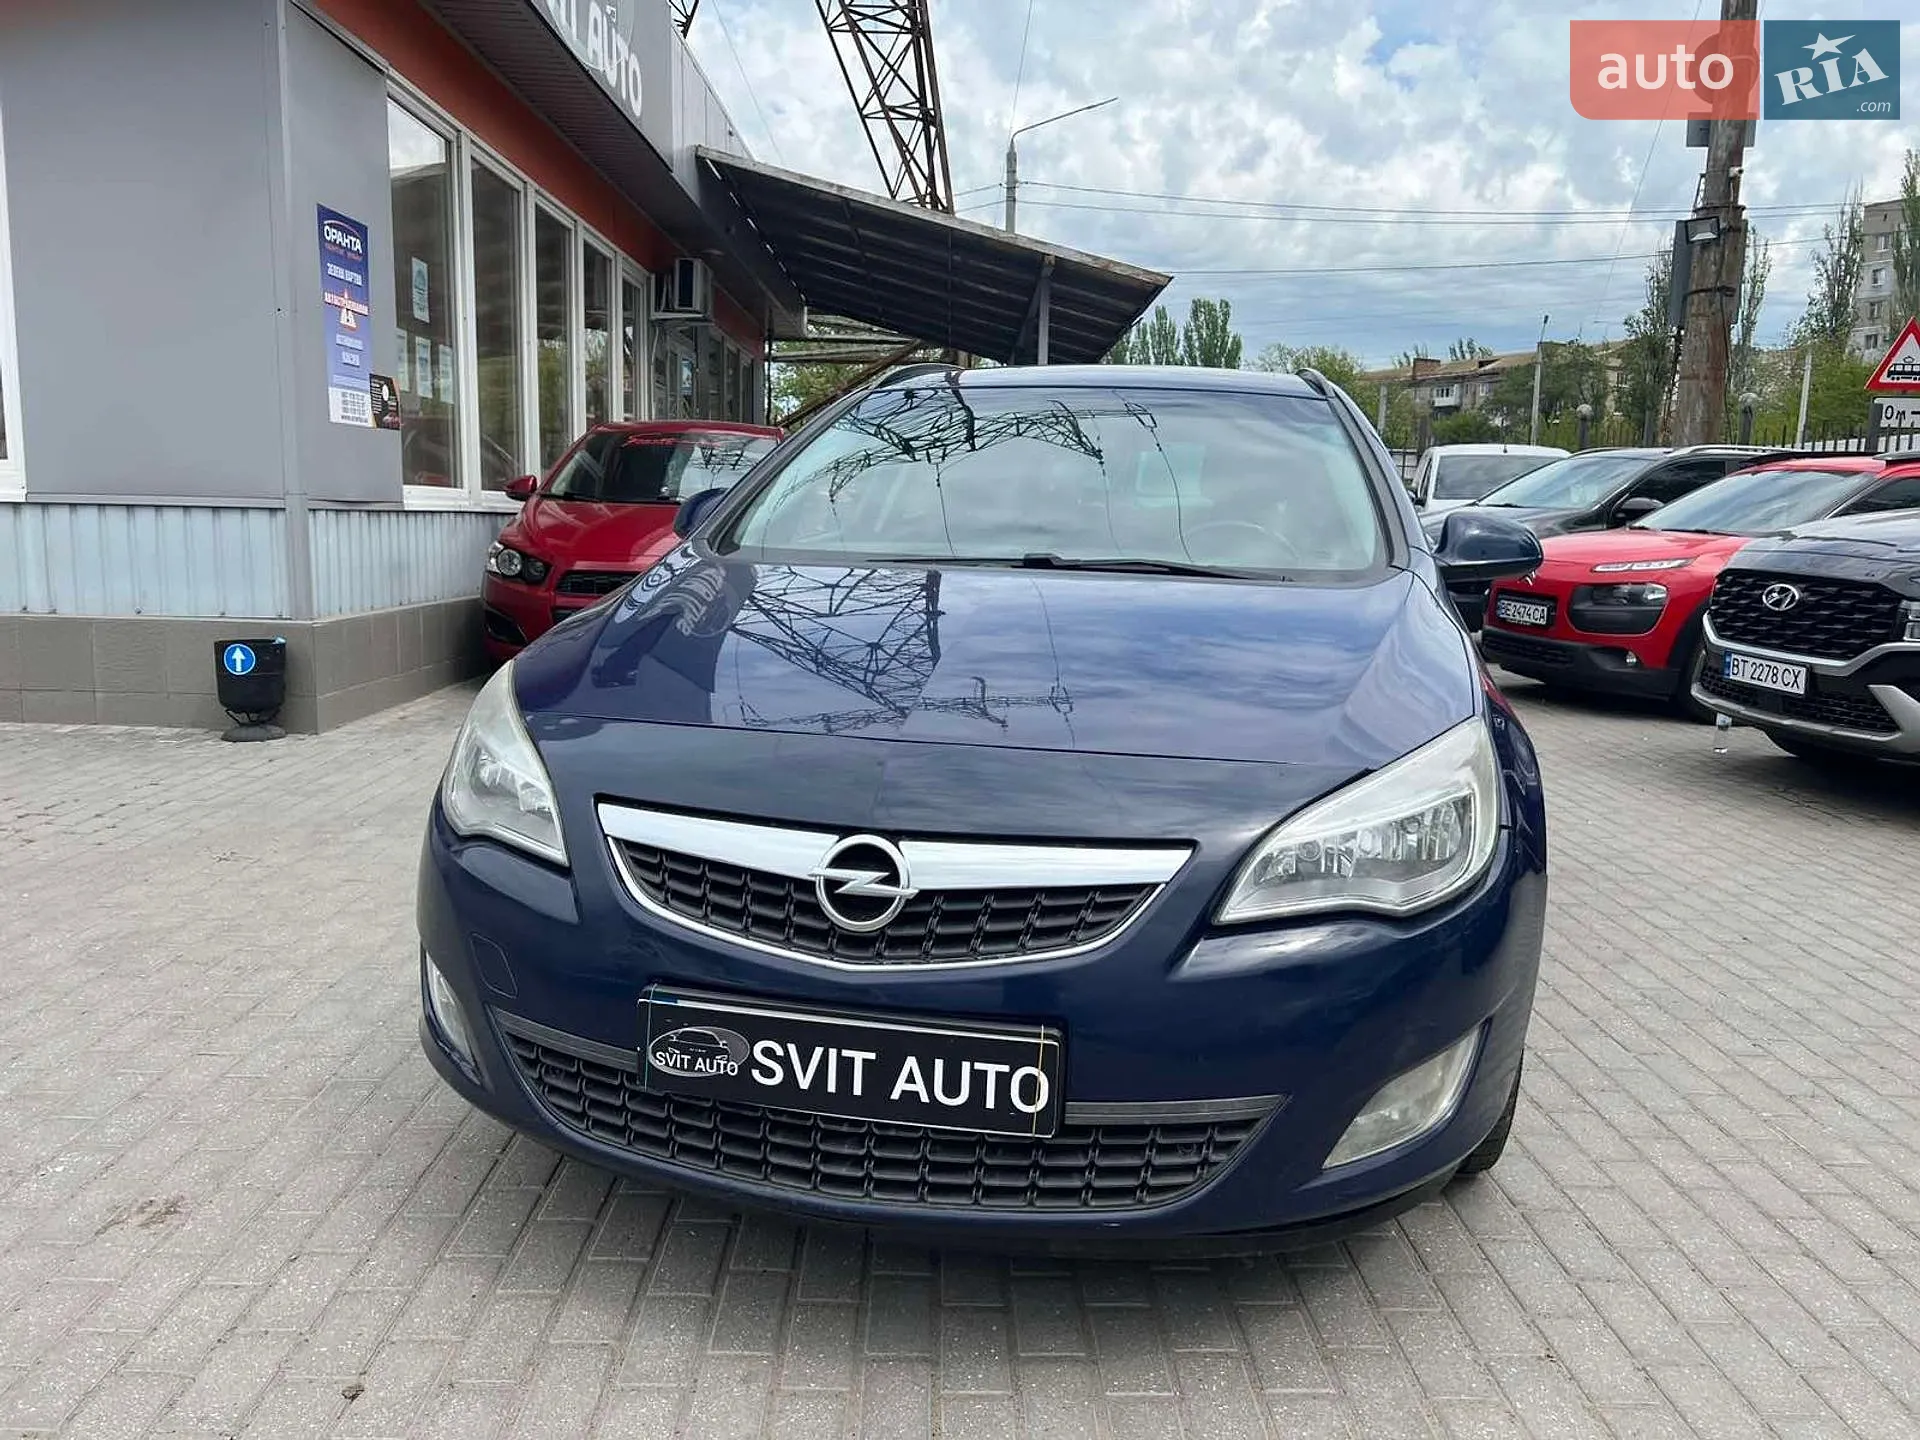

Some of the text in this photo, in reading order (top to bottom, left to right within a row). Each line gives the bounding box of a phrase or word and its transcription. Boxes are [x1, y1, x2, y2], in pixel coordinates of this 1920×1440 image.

[587, 1, 642, 116] AUTO
[323, 225, 363, 254] ОРАНТА
[1731, 657, 1801, 689] BT 2278 CX
[655, 1051, 738, 1076] SVIT AUTO
[751, 1039, 1049, 1114] SVIT AUTO
